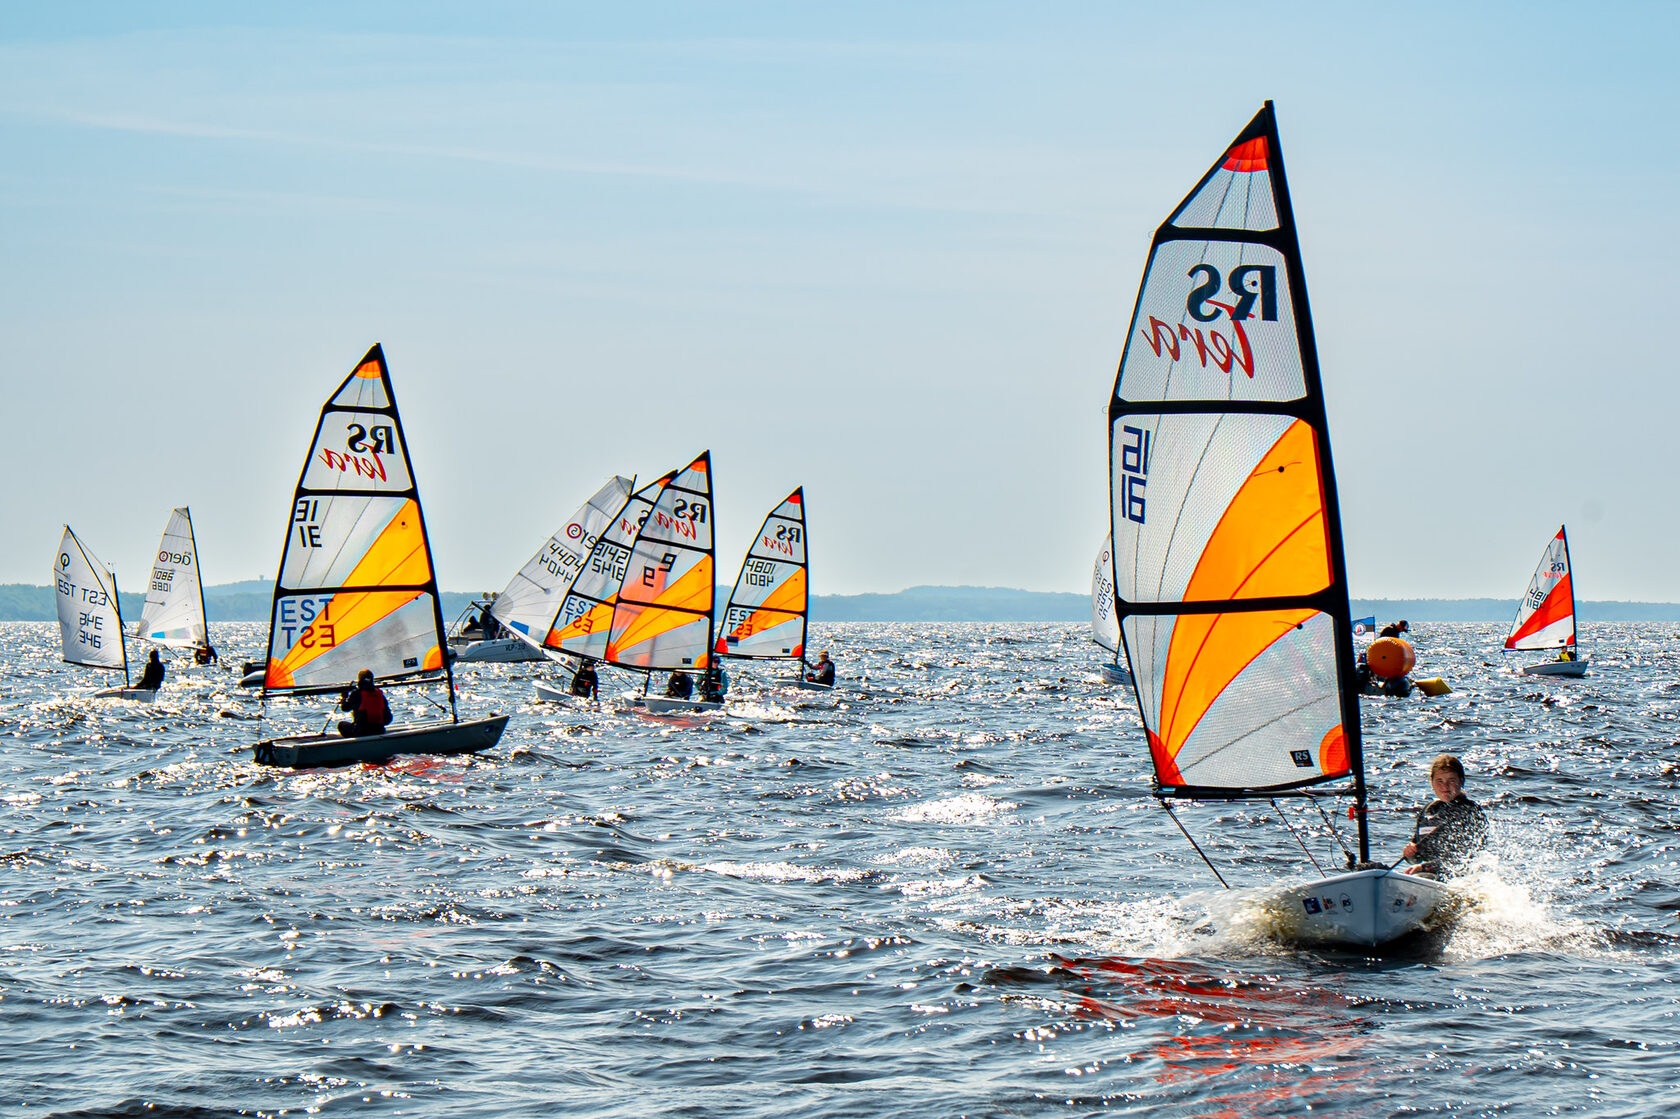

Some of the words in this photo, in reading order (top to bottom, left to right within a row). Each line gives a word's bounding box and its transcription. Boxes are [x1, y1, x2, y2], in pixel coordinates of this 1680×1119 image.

[1121, 472, 1147, 525] 16
[549, 543, 584, 572] 4404
[593, 541, 629, 565] 3142
[153, 570, 174, 581] 1086
[746, 559, 776, 575] 4801
[58, 579, 76, 597] EST
[281, 598, 334, 623] EST
[566, 596, 597, 617] EST
[729, 608, 756, 622] EST
[79, 629, 101, 649] 346
[1295, 751, 1308, 761] RS
